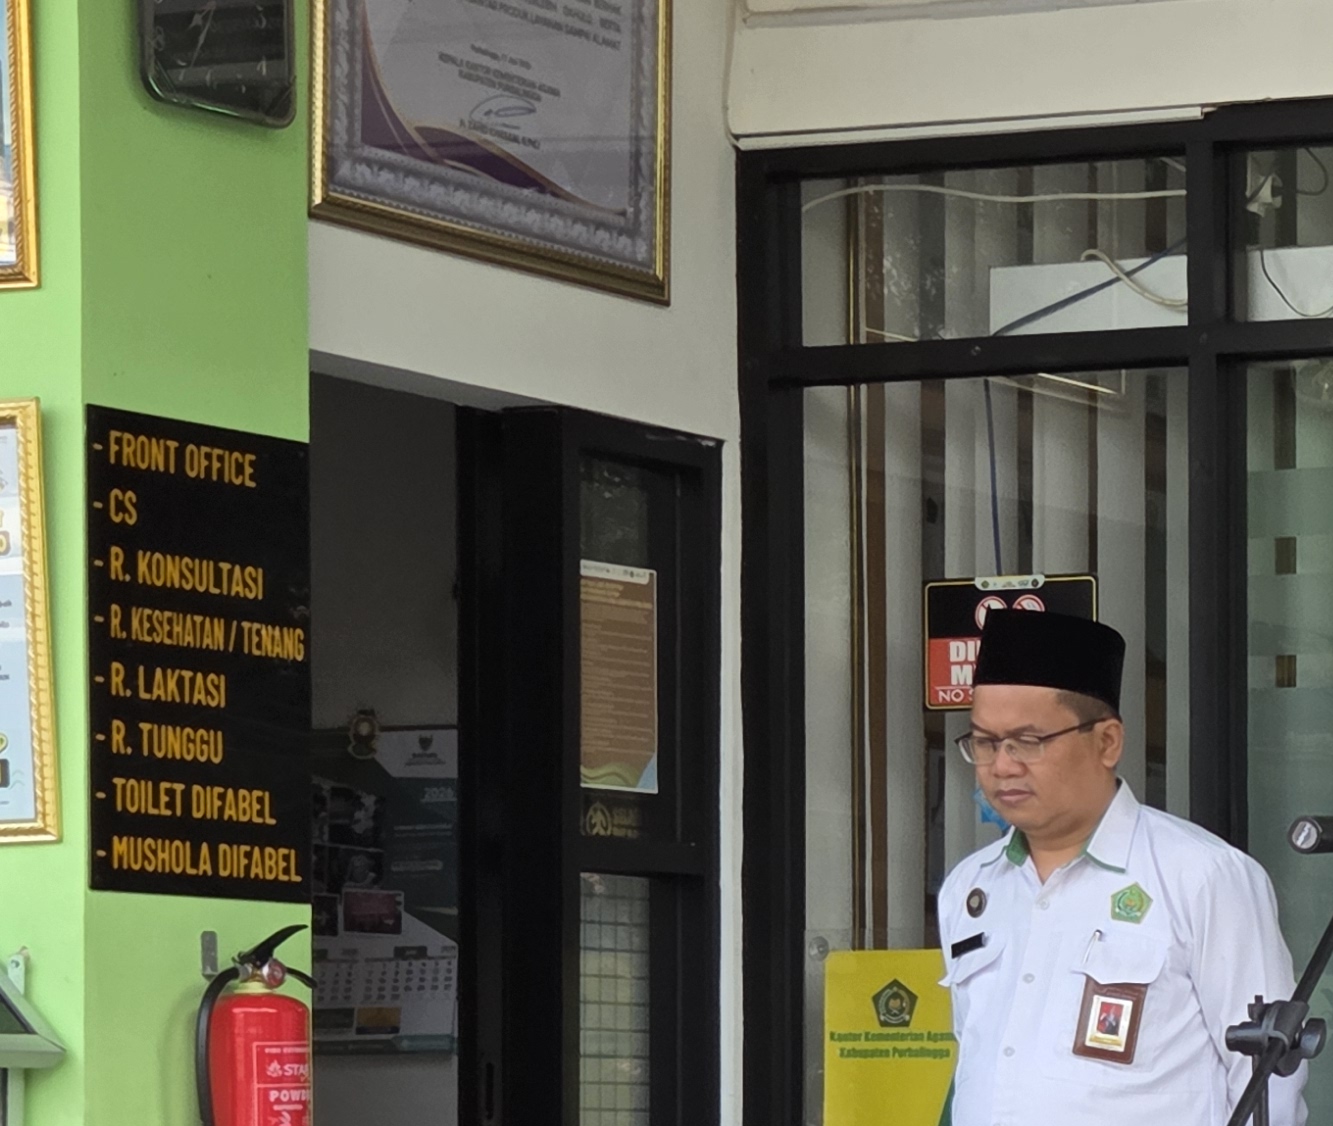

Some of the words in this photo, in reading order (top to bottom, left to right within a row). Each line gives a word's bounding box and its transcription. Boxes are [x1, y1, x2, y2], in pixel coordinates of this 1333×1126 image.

[109, 430, 178, 475] FRONT
[185, 443, 257, 489] OFFICE
[109, 488, 138, 527] CS
[110, 546, 131, 583] R.
[138, 550, 263, 600] KONSULTASI
[110, 604, 127, 639] R.
[131, 607, 225, 652] KESEHATAN
[241, 621, 305, 662] TENANG
[110, 661, 132, 698] R.
[138, 665, 226, 709] LAKTASI
[938, 689, 964, 703] NO
[111, 720, 133, 756] R.
[139, 722, 223, 765] TUNGGU
[113, 777, 186, 815] TOILET
[192, 783, 277, 826] DIFABEL
[112, 835, 212, 877] MUSHOLA
[218, 841, 302, 883] DIFABEL
[284, 1063, 309, 1077] STA
